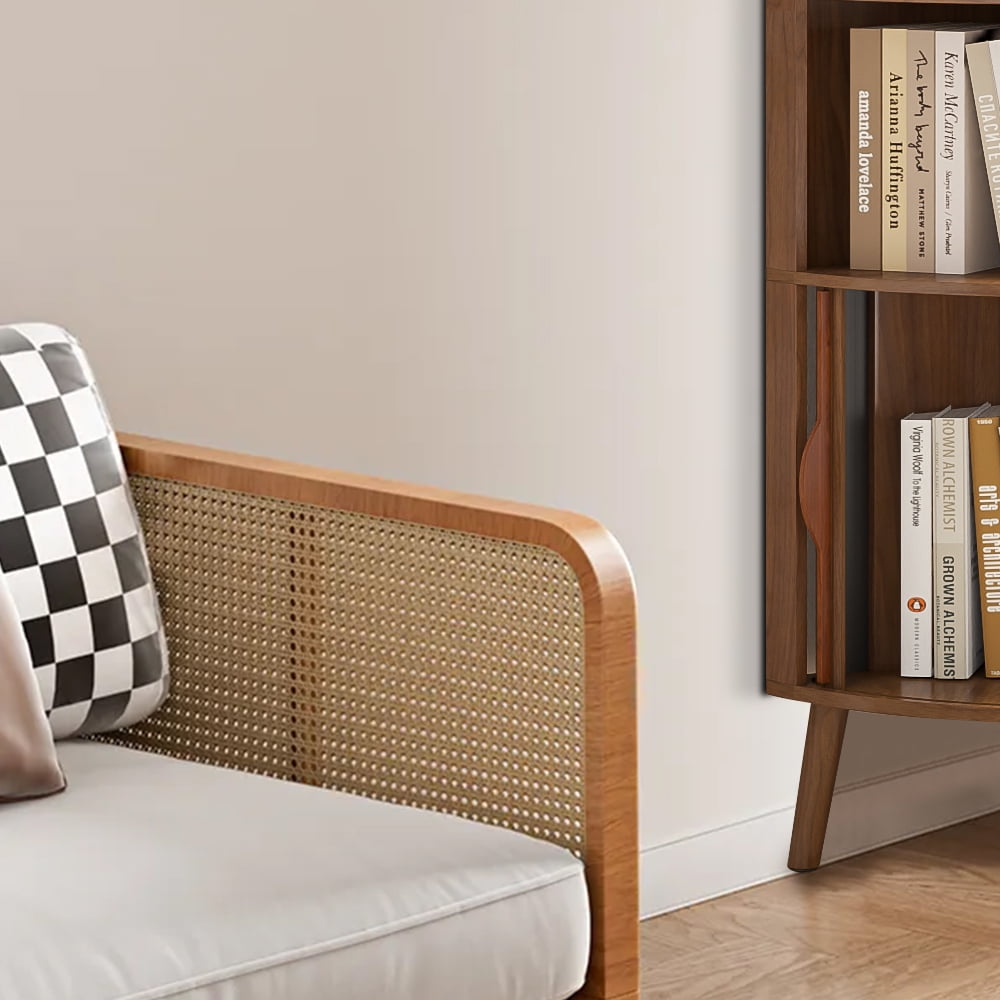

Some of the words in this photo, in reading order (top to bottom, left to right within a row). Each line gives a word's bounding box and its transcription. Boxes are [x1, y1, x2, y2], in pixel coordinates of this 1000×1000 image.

[913, 50, 929, 81] The
[944, 51, 959, 88] Karen
[858, 90, 873, 148] amanda
[889, 72, 903, 135] Arianna
[914, 85, 932, 117] body
[908, 124, 930, 173] beyond
[940, 93, 959, 161] McCartney
[858, 152, 873, 213] lovelace
[885, 141, 903, 230] Huffington
[910, 426, 924, 453] Virginia
[912, 454, 924, 475] Woolf
[910, 496, 921, 527] Lighthouse
[943, 461, 956, 533] ALCHEMIST
[978, 485, 1000, 511] arts
[980, 518, 999, 527] &
[943, 556, 955, 605] GROWN
[943, 610, 955, 679] ALCHEMIS
